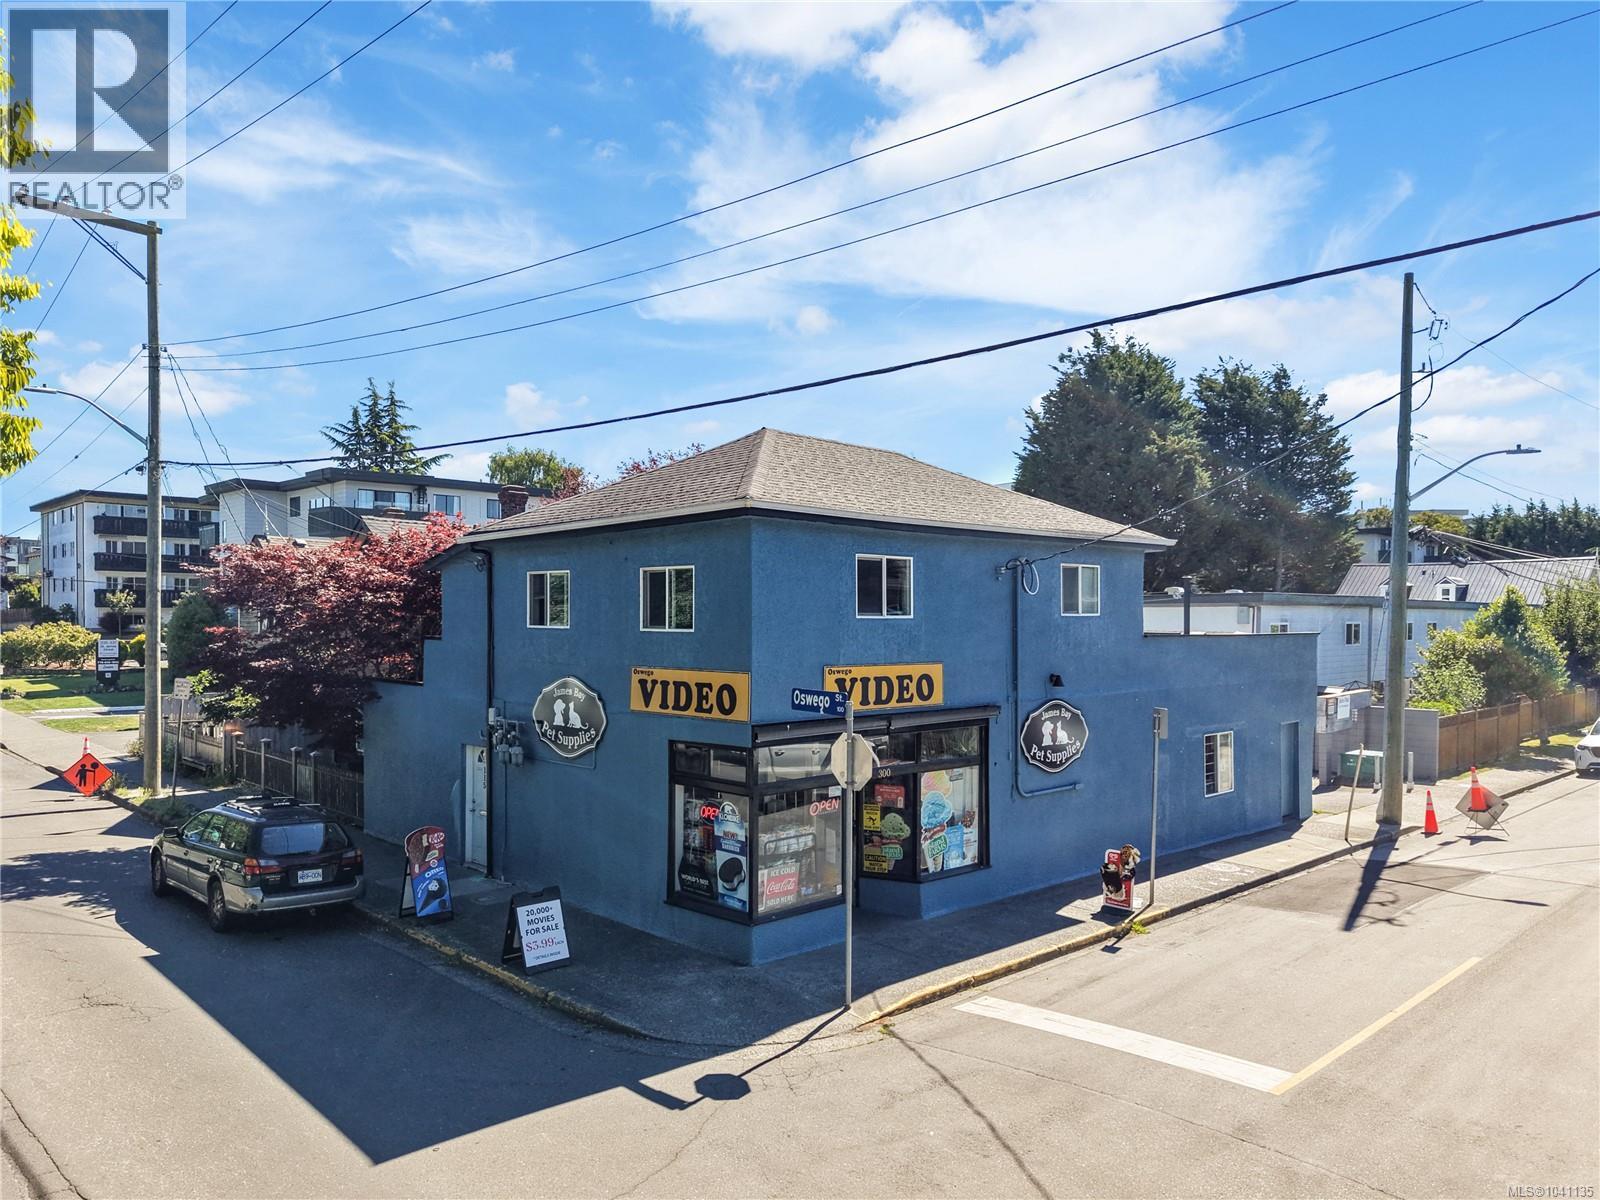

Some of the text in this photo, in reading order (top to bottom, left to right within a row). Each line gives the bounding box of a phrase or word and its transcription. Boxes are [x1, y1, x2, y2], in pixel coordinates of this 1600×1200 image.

[633, 668, 654, 677] Oswego
[827, 668, 852, 676] Oswego
[553, 687, 586, 702] James Bay
[835, 673, 935, 706] VIDEO
[638, 679, 737, 716] VIDEO
[793, 690, 830, 711] Oswego
[1041, 708, 1072, 720] James Bay
[541, 720, 596, 749] Pet Supplies
[1030, 740, 1081, 764] Pet Supplies
[878, 769, 891, 778] 300
[809, 798, 839, 816] OPEN
[770, 865, 796, 877] ICE COLD
[527, 914, 555, 926] MOVIES
[525, 923, 560, 936] FOR SALE
